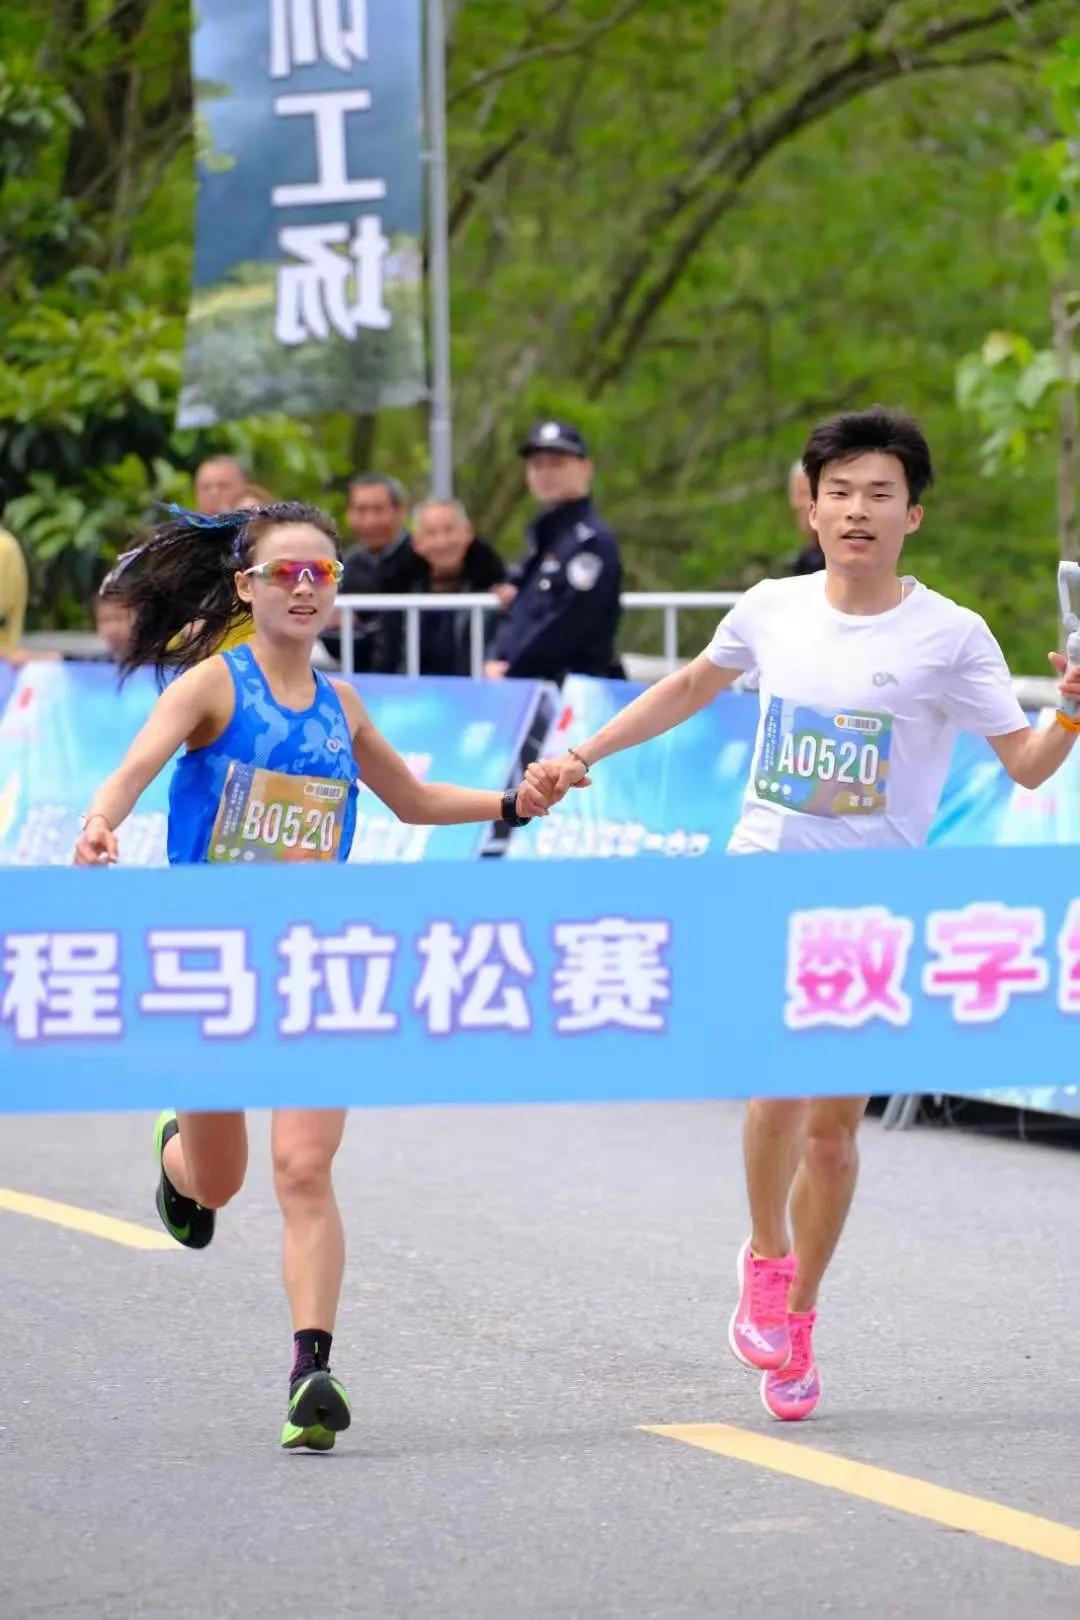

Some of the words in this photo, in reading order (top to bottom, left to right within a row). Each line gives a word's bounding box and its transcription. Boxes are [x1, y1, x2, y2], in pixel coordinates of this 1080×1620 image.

[778, 732, 879, 785] A0520
[243, 800, 336, 852] B0520
[2, 918, 671, 1040] 程马拉松赛
[785, 902, 1080, 1029] 数字
